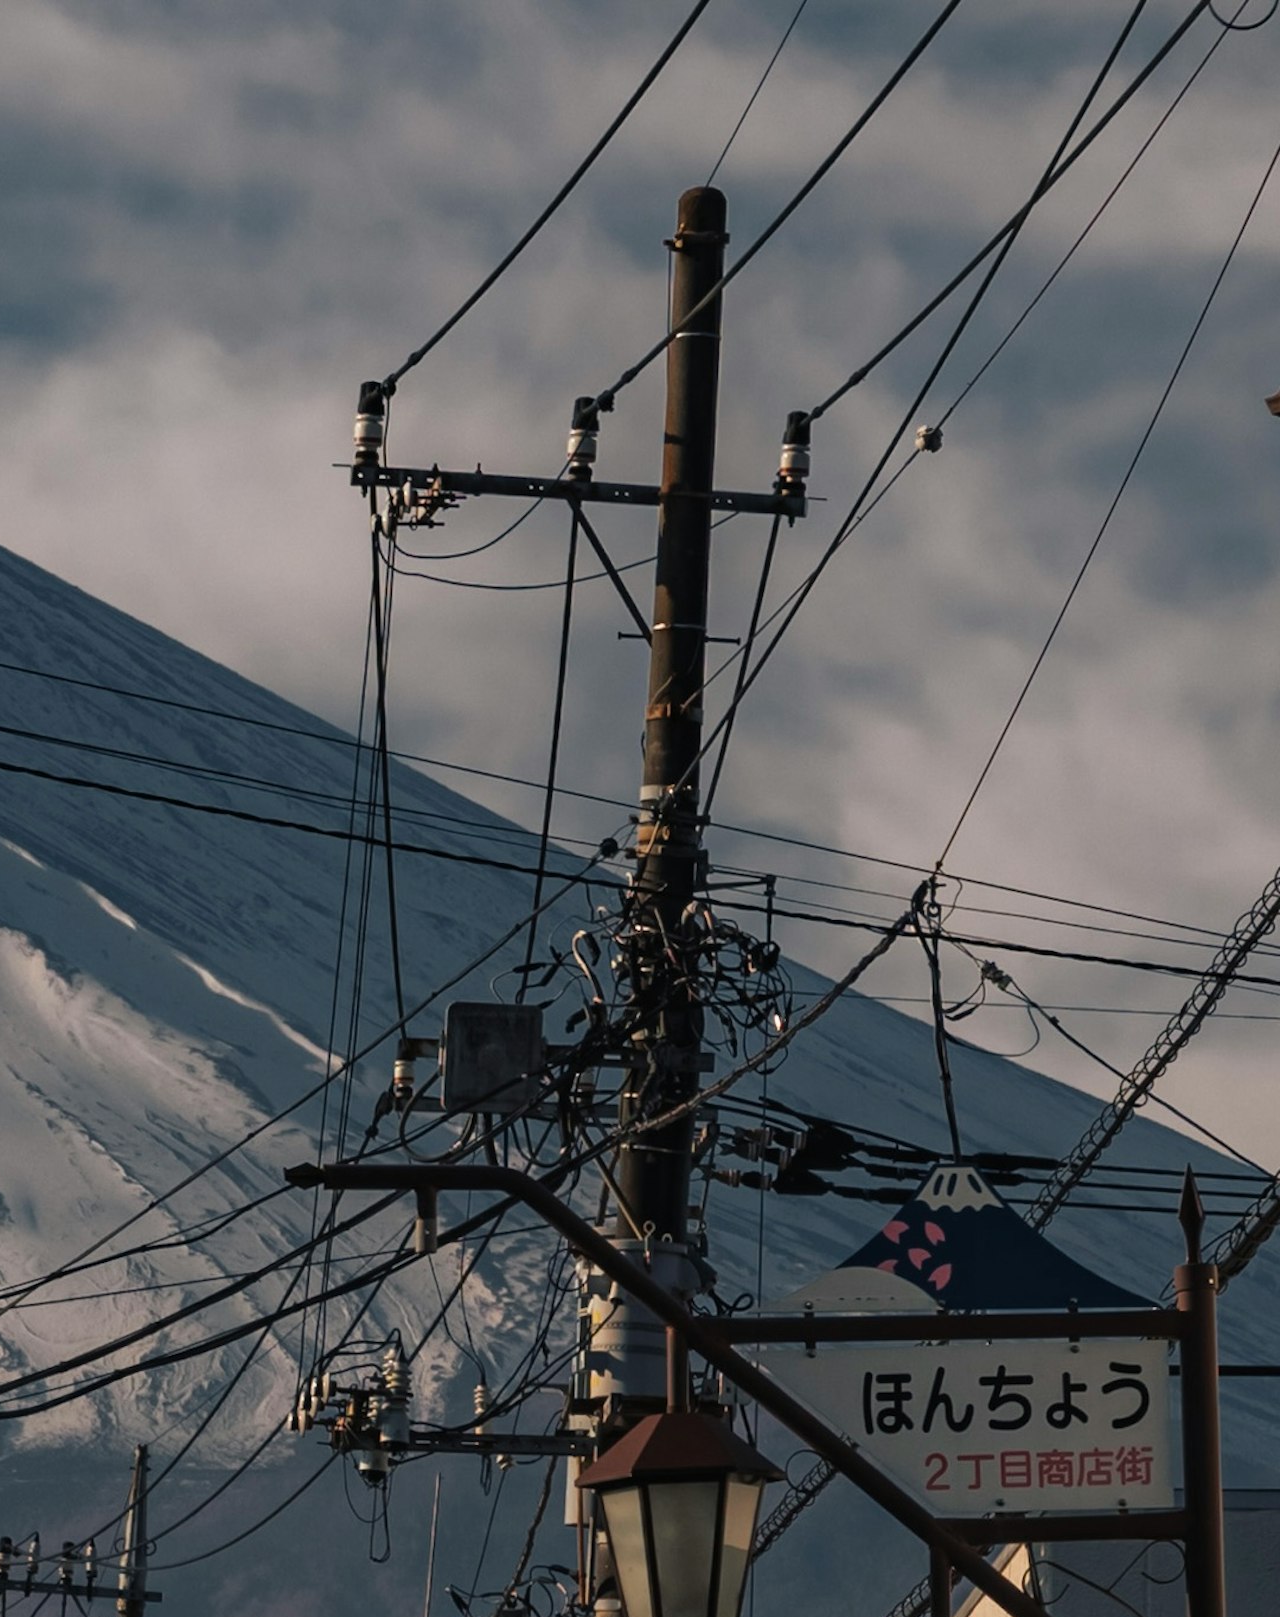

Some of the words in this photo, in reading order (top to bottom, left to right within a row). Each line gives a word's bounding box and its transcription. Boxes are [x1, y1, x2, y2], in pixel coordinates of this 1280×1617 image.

[862, 1361, 1150, 1435] ほんちょう
[924, 1446, 1153, 1491] 2丁目商店街
